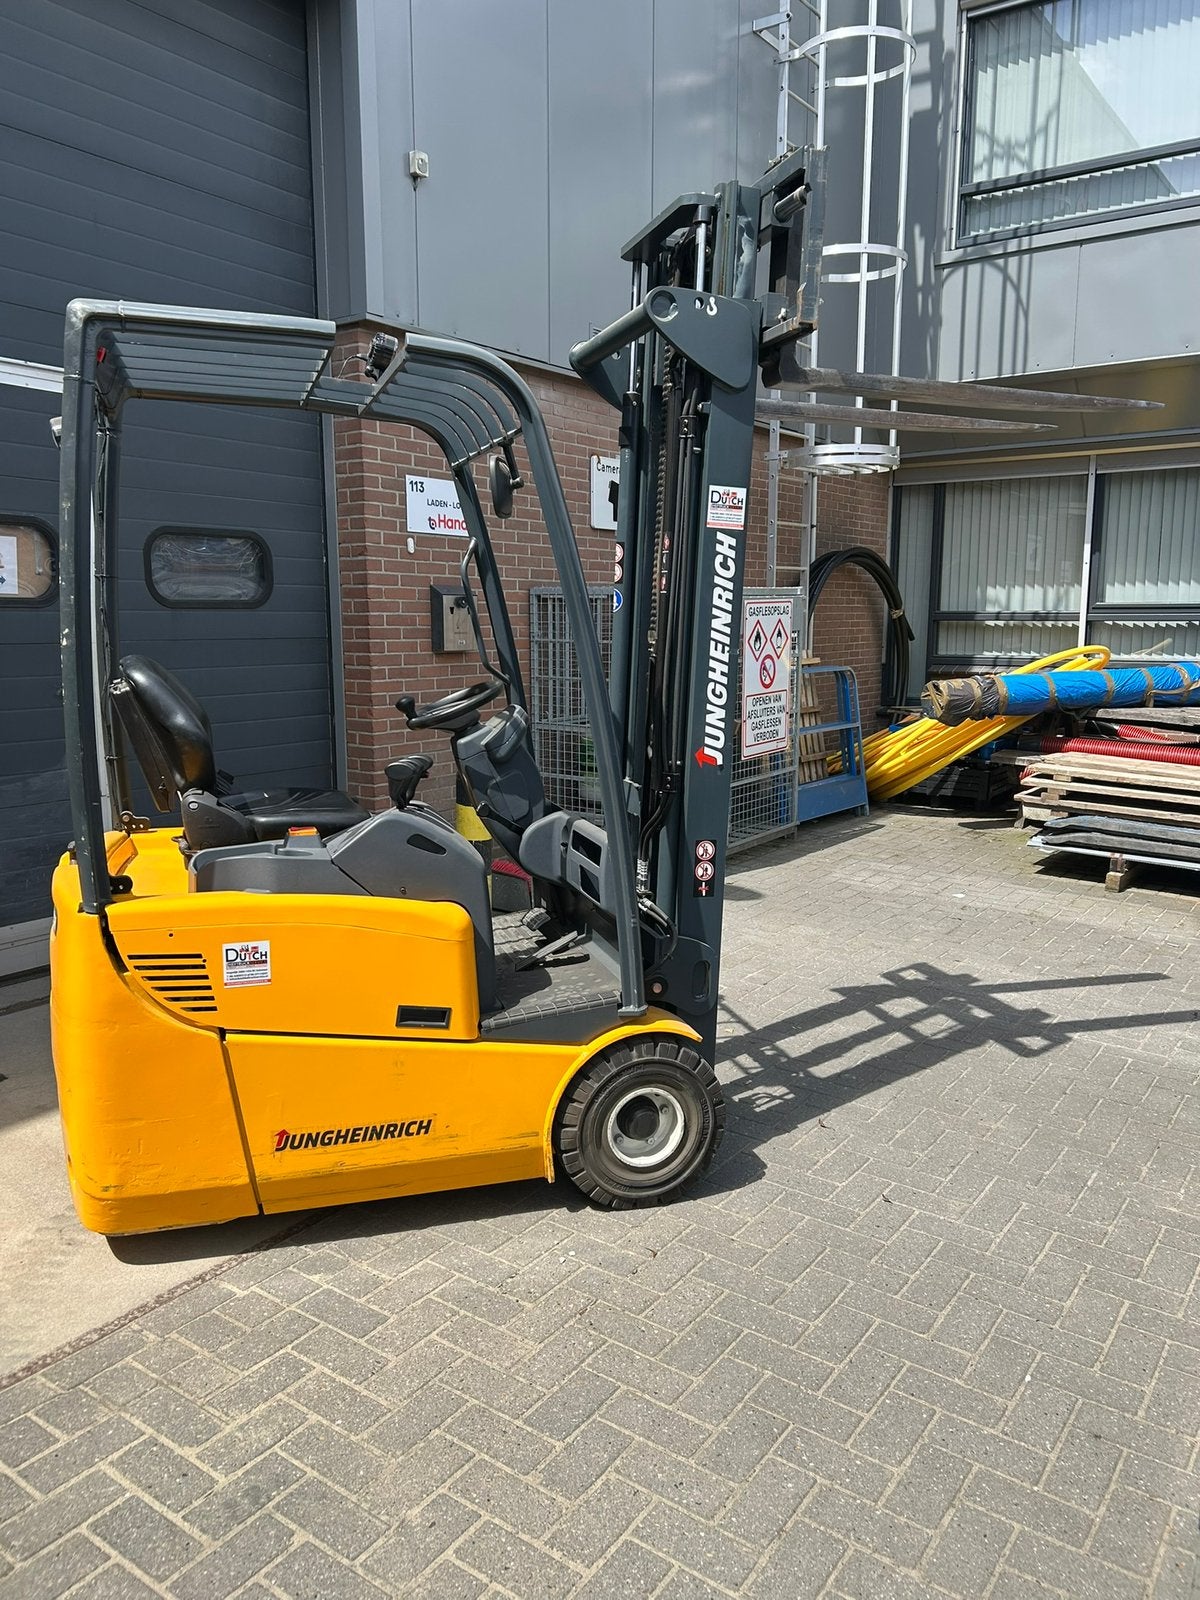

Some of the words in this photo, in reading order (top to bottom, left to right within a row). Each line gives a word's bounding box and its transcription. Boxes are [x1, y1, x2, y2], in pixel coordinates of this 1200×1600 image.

[597, 461, 620, 474] Camer
[409, 480, 425, 493] 113
[427, 498, 448, 508] LADEN
[749, 605, 790, 617] GASFLESOPSLAG
[695, 531, 737, 768] JUNGHEINRICH
[752, 695, 771, 707] OPENEN
[773, 694, 782, 703] VAN
[747, 706, 776, 720] AFSLUITERS
[777, 705, 785, 714] VAN
[751, 717, 781, 731] GASFLESSEN
[753, 729, 779, 742] VERBODEN
[274, 1119, 432, 1152] JUNGHEINRICH
